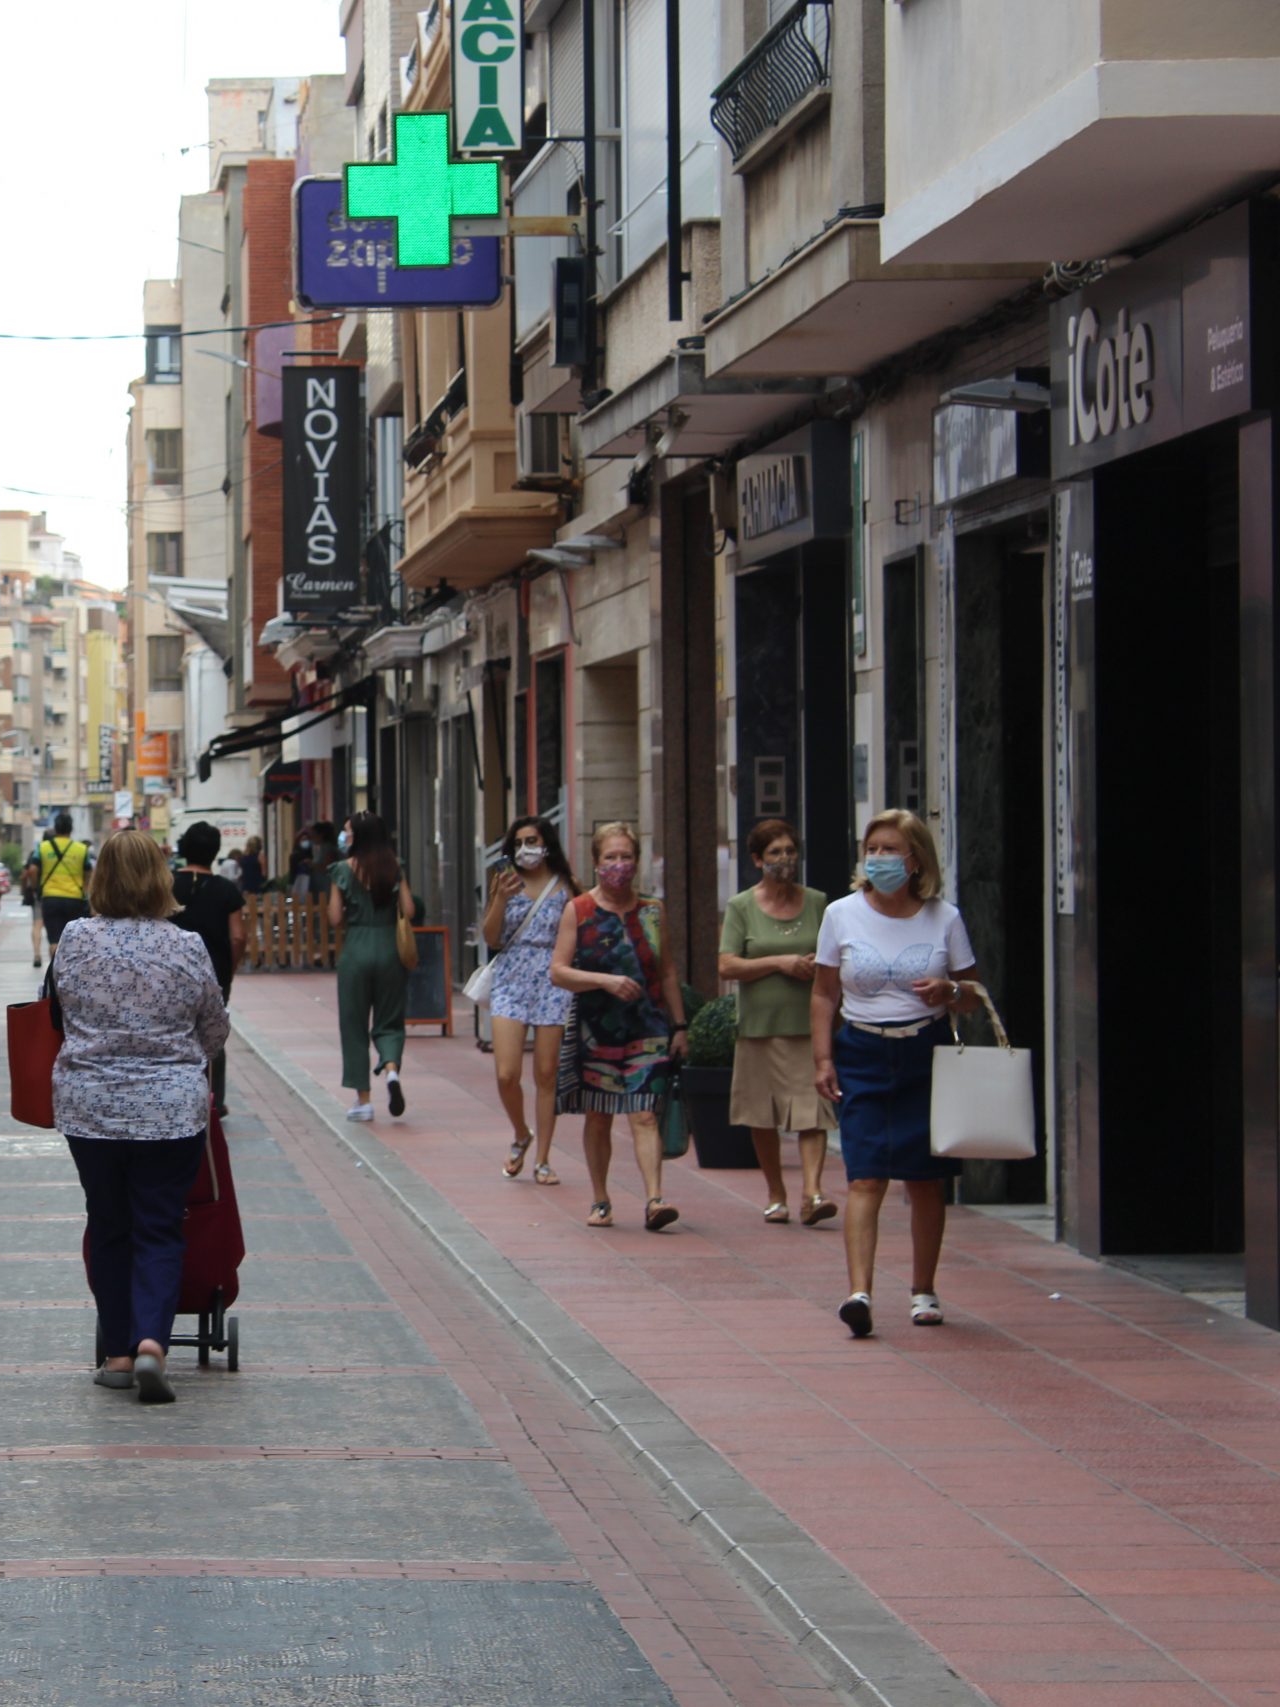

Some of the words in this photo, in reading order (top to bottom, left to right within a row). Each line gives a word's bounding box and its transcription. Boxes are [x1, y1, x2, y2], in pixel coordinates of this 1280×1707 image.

[1067, 307, 1153, 446] iCote
[303, 377, 339, 566] NOVIAS
[285, 571, 357, 592] Carmen
